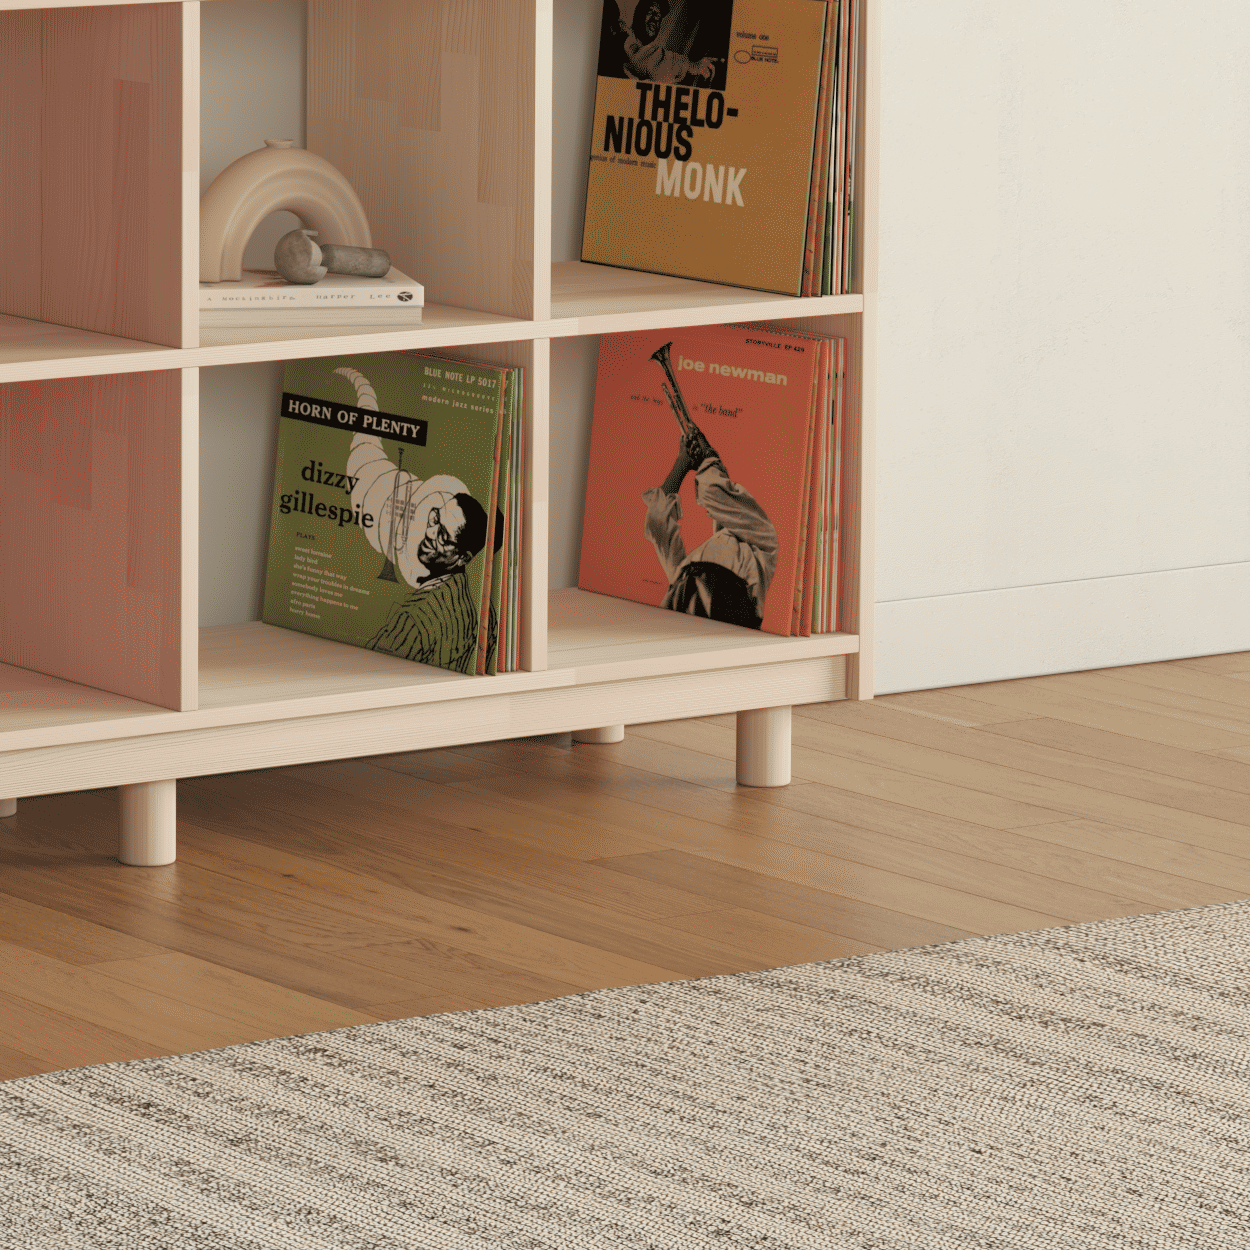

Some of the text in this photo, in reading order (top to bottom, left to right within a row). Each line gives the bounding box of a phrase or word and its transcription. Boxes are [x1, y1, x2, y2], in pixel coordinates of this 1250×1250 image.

[636, 82, 739, 130] THELO-
[603, 115, 694, 162] NIOUS
[655, 158, 747, 207] MONK
[425, 367, 497, 388] BLUE NOTE LP 5017
[678, 355, 788, 386] joe newman
[288, 400, 421, 438] HORN OF PLENTY
[422, 395, 494, 415] modern jazz series
[301, 459, 360, 495] dizzy
[279, 490, 375, 529] gillespie
